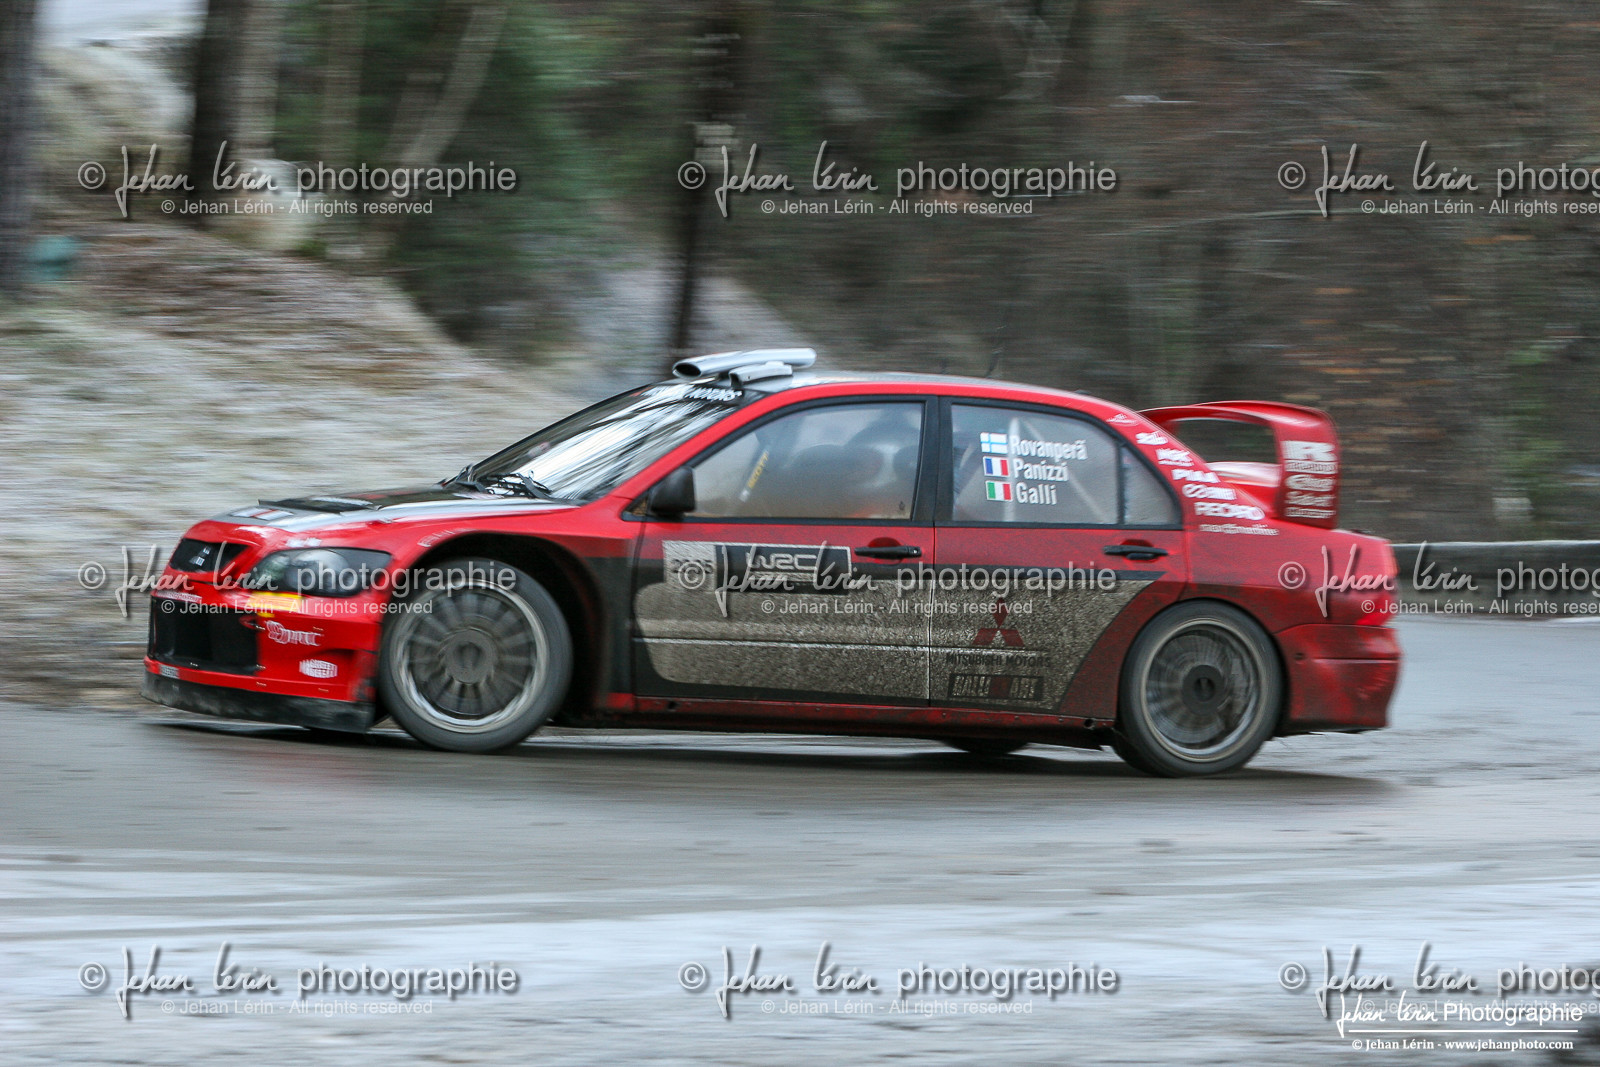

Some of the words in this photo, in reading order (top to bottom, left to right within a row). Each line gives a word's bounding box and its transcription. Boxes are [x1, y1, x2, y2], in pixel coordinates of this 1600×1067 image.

[1011, 436, 1088, 462] Rovanperä
[1013, 458, 1068, 481] Panizzi
[1016, 482, 1057, 505] Galli
[946, 653, 1002, 666] MITSUBISHI
[1006, 655, 1052, 668] MOTORS
